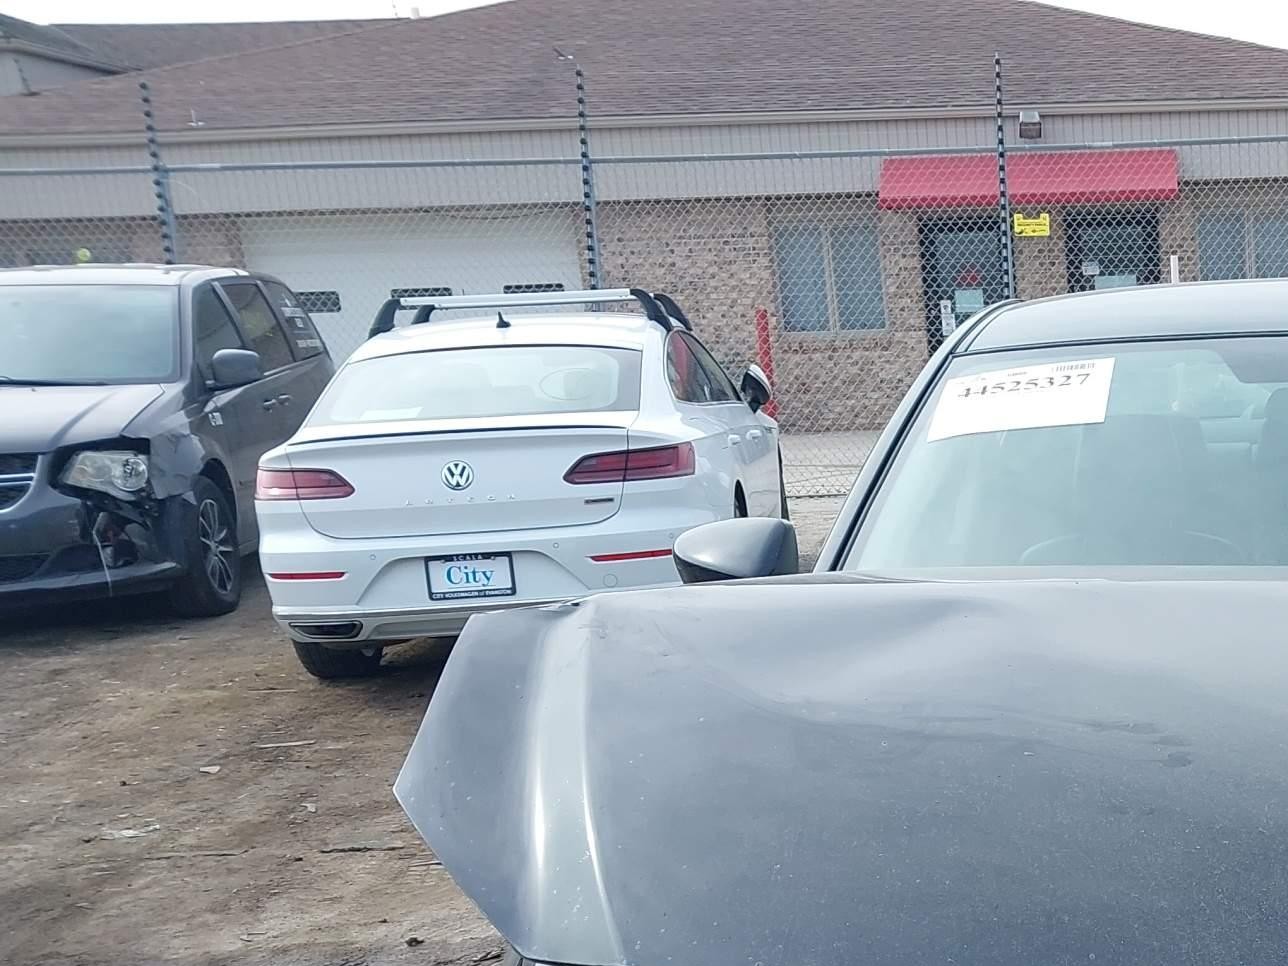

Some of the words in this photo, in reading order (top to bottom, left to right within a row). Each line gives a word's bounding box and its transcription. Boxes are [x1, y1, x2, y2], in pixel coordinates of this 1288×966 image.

[957, 373, 1091, 399] 44525327
[443, 461, 472, 488] VW
[446, 565, 496, 587] City
